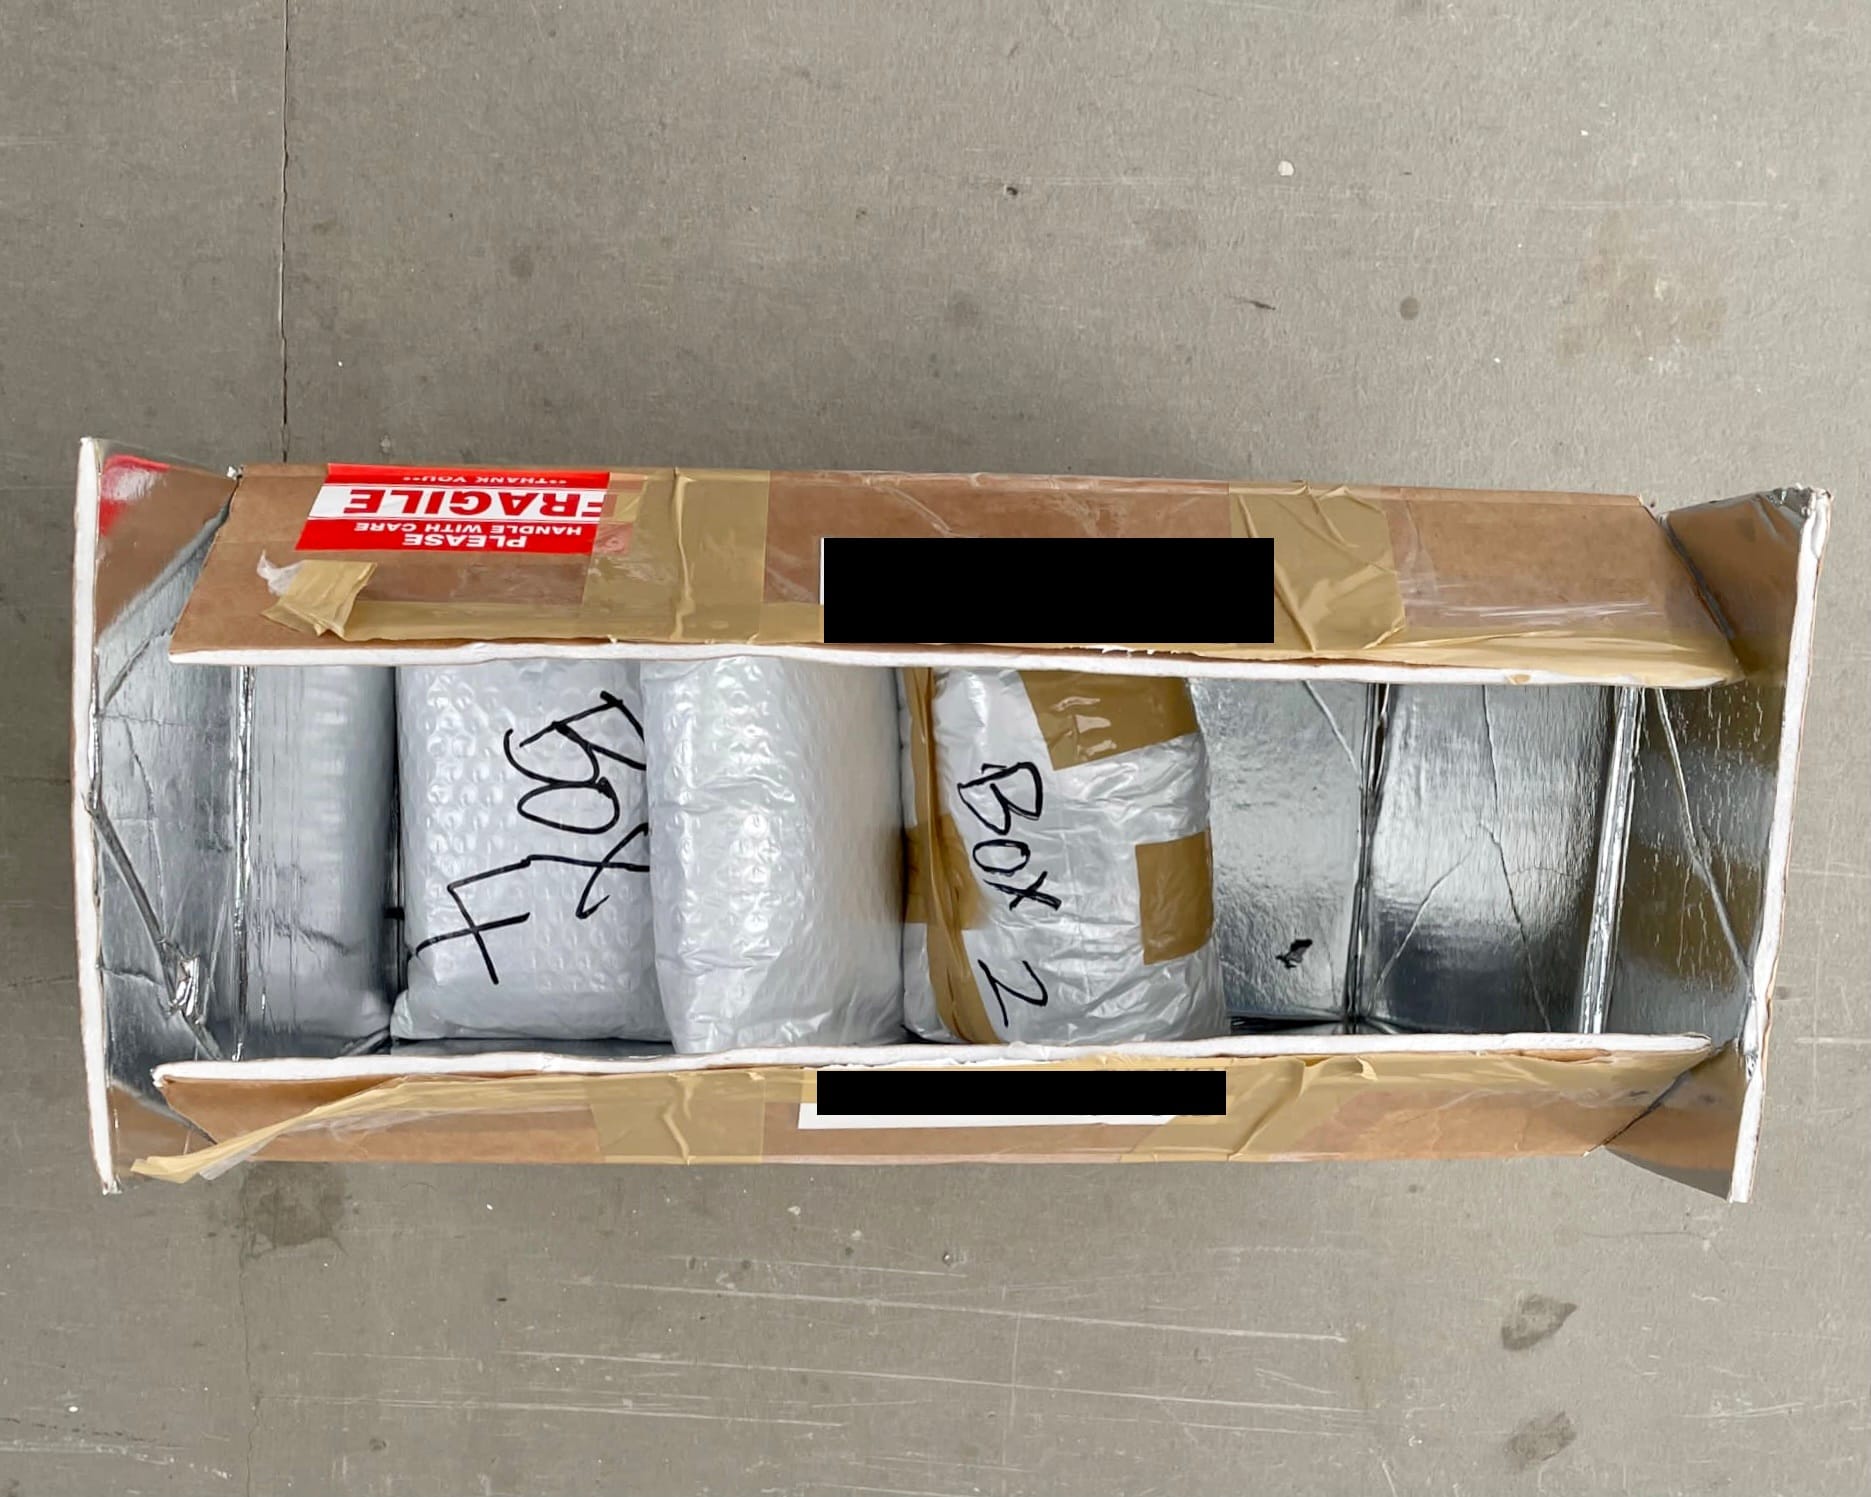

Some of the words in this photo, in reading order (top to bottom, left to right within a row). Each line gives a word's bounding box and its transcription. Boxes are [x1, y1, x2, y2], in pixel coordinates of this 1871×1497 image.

[343, 489, 606, 518] FRAGILE
[354, 522, 417, 533] CARE
[425, 523, 483, 534] WITH
[491, 524, 583, 536] HANDLE
[403, 534, 528, 549] PLEASE
[415, 858, 531, 985] 4
[977, 958, 1048, 1028] 2
